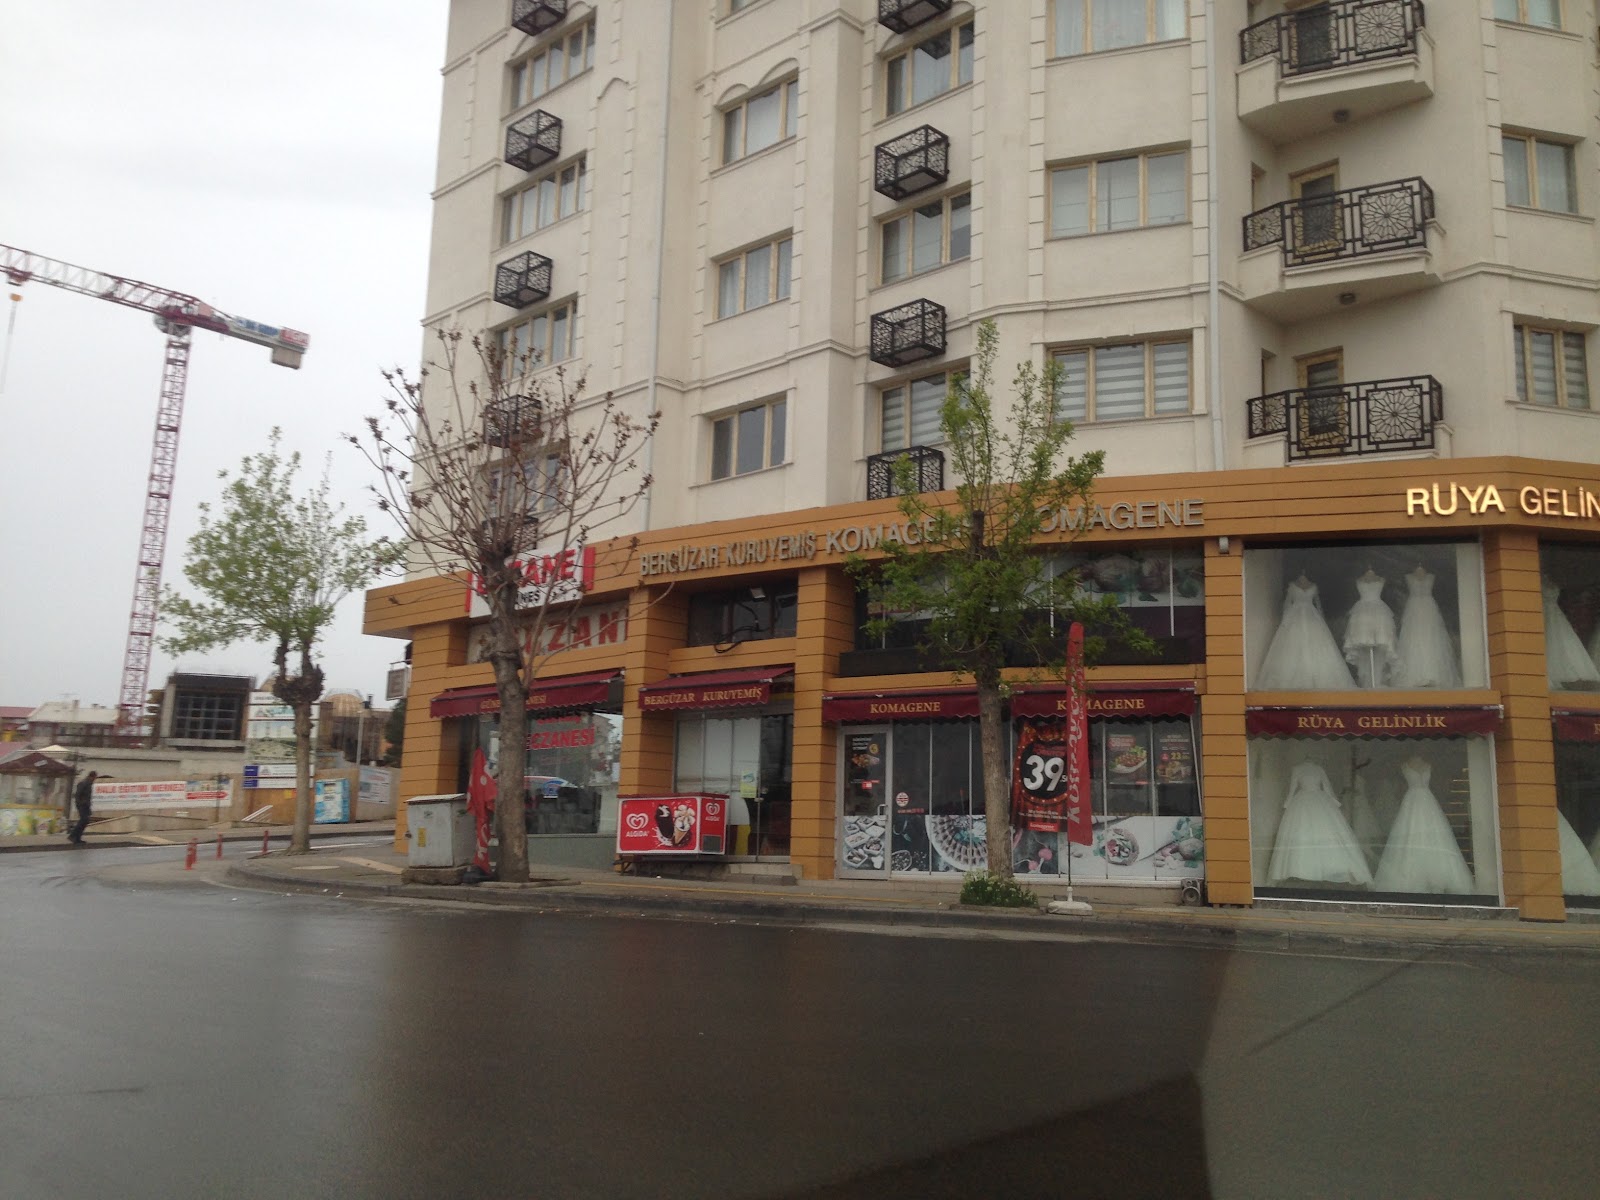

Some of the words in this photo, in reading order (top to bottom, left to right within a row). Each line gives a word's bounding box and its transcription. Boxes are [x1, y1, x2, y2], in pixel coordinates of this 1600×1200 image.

[1406, 481, 1506, 516] RÜYA
[1013, 497, 1204, 534] OMAGENE
[644, 692, 695, 705] BERGÜZAR
[702, 686, 763, 702] KURUYEMİŞ
[870, 701, 941, 714] KOMAGENE
[1056, 698, 1146, 711] KAGENE
[1297, 714, 1345, 728] RÜYA
[1357, 713, 1448, 728] GELİNLİK
